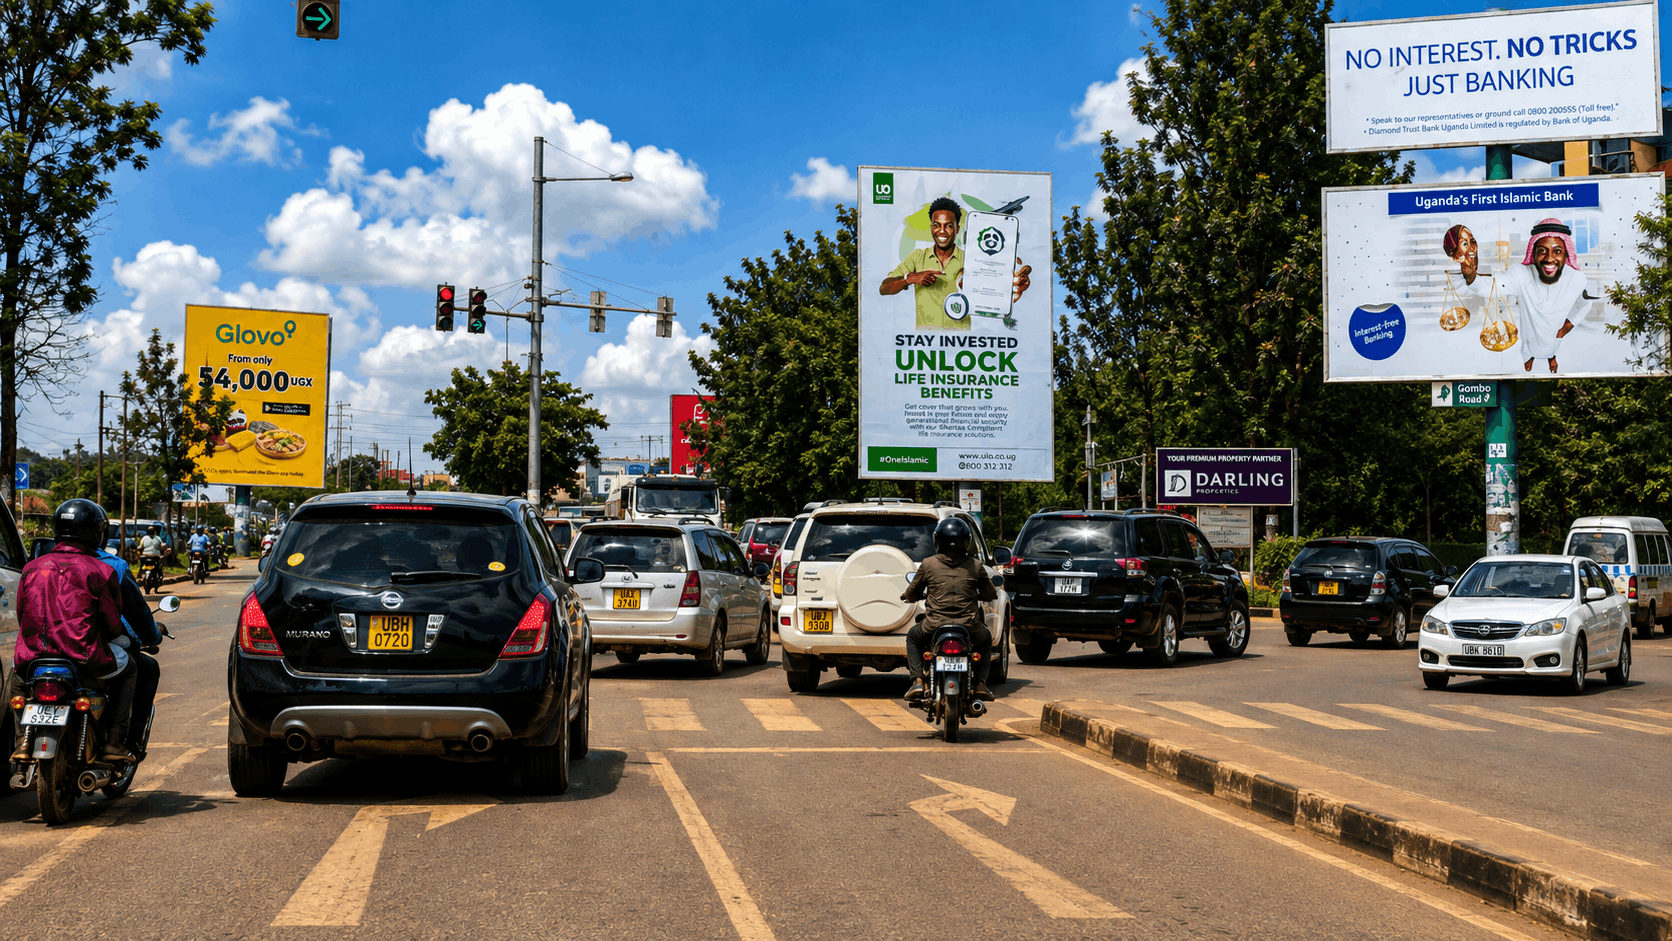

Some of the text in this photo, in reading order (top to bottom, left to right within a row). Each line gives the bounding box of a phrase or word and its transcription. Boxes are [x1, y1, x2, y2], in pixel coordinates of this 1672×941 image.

[1345, 29, 1637, 70] NO INTEREST. NO TRICKS
[1403, 65, 1574, 97] JUST BANKING
[1371, 115, 1393, 125] Speak
[1394, 115, 1403, 123] to
[1403, 115, 1416, 123] our
[1417, 111, 1474, 124] representatives
[1475, 111, 1483, 119] or
[1484, 108, 1512, 120] ground
[1512, 107, 1526, 117] call
[1527, 107, 1547, 116] 0800
[1578, 103, 1595, 114] (Toll
[1368, 125, 1401, 136] Diamond
[1402, 124, 1421, 133] Trust
[1421, 123, 1440, 132] Bank
[1470, 120, 1497, 130] Limited
[1498, 119, 1504, 128] is
[1541, 116, 1551, 128] by
[1552, 116, 1571, 125] Bank
[1572, 115, 1580, 124] of
[1415, 190, 1574, 209] Uganda's First Islamic Bank
[215, 323, 285, 346] Glovo
[895, 334, 1018, 349] STAY INVESTED
[228, 353, 273, 366] From only
[895, 349, 1019, 373] UNLOCK
[198, 366, 313, 394] 54,000 UGX
[894, 372, 1019, 386] LIFE INSURANCE
[920, 386, 993, 400] BENEFITS
[1458, 383, 1491, 393] Gombo
[1459, 394, 1482, 404] Road
[1196, 472, 1284, 487] DARLING
[381, 616, 409, 632] UBH
[285, 630, 331, 639] MURANO
[374, 633, 409, 648] 0720
[1464, 645, 1479, 655] UBK
